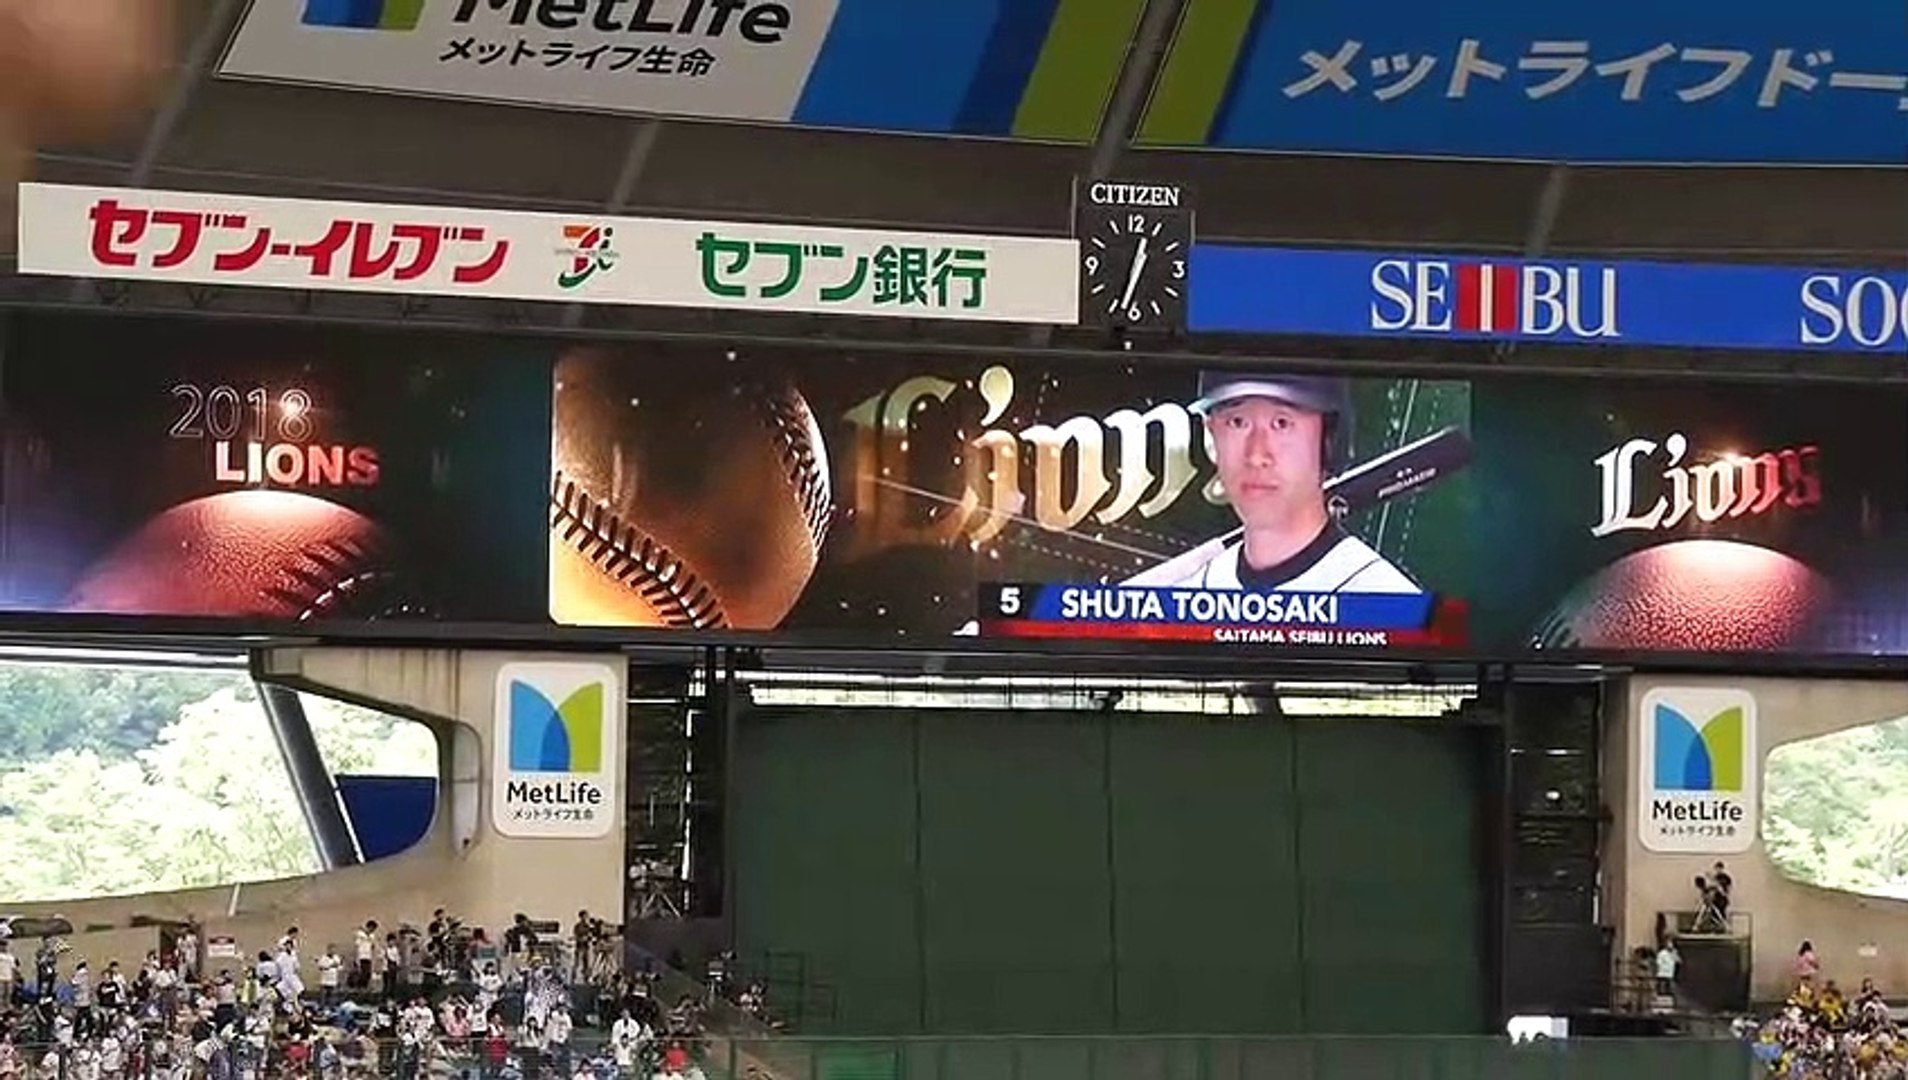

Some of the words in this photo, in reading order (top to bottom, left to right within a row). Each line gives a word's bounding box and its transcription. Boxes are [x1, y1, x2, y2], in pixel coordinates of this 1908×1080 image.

[440, 37, 716, 77] メットライフ生命
[1282, 38, 1908, 110] メットライフドー
[1091, 183, 1180, 206] CITIZEN
[1128, 214, 1145, 233] 12
[696, 232, 987, 308] セブン銀行
[1085, 256, 1099, 276] 9
[1172, 260, 1185, 278] 3
[1127, 302, 1142, 321] 6
[1372, 260, 1620, 337] SEIBU
[1802, 275, 1908, 346] SO
[169, 384, 313, 442] 2018
[215, 441, 380, 485] LIONS
[1000, 588, 1020, 614] 5
[1061, 588, 1162, 619] SHUTA
[1173, 592, 1339, 623] TONOSAKI
[507, 781, 602, 804] MetLife
[1652, 800, 1743, 822] MetLife
